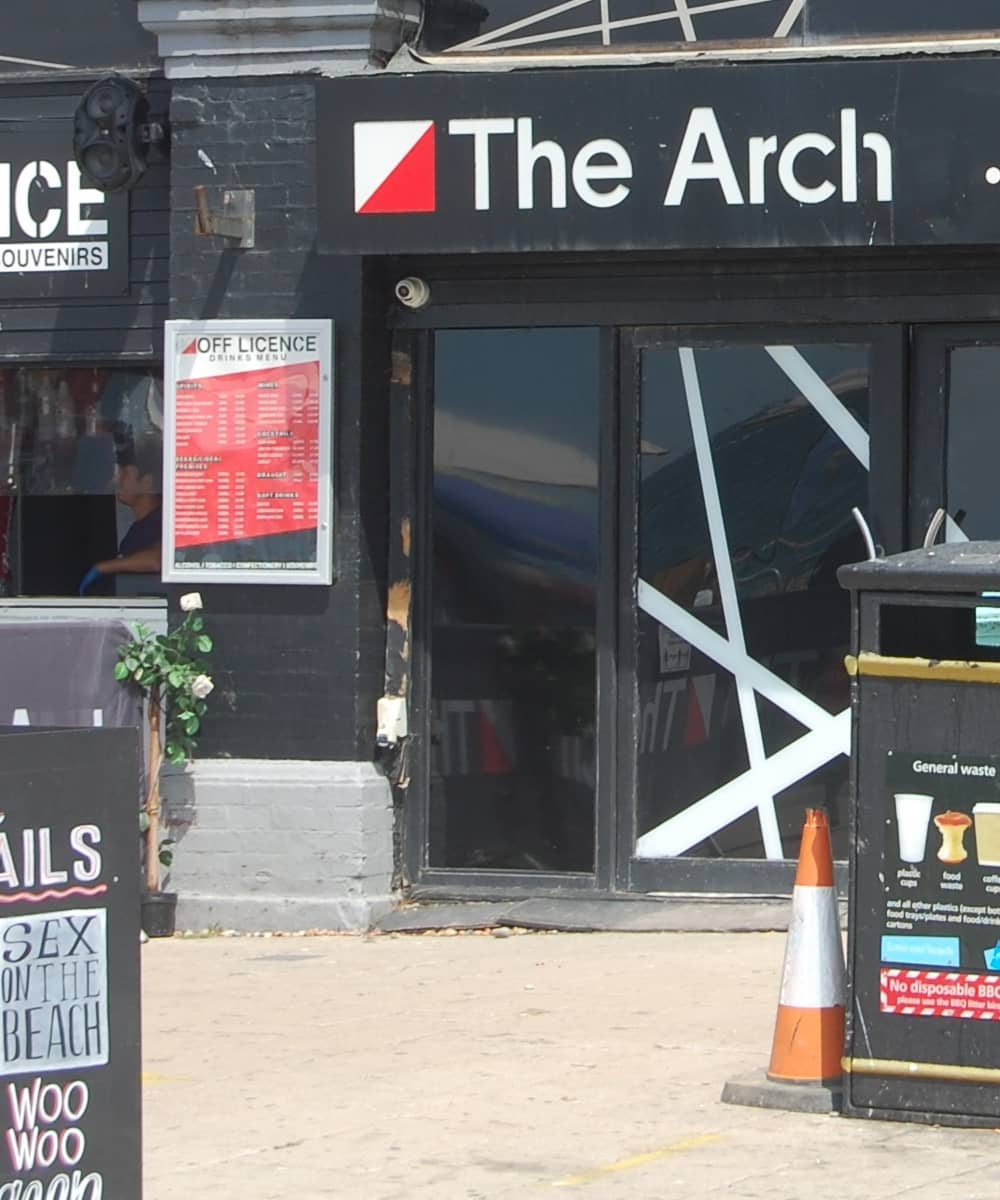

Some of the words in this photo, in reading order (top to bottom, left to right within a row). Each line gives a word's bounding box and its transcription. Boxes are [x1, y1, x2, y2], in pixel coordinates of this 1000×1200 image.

[449, 117, 633, 210] The
[663, 107, 892, 206] Arch
[0, 161, 108, 238] CE
[0, 246, 103, 268] OUVENIRS
[197, 337, 232, 353] OFF
[239, 335, 317, 352] LICENCE
[209, 354, 251, 362] DRINKS
[257, 353, 288, 361] MENU
[913, 760, 958, 774] General
[960, 764, 996, 777] waste
[2, 915, 98, 963] SEX
[1, 963, 32, 1003] ON
[36, 959, 100, 1003] THE
[889, 979, 908, 992] No
[911, 980, 975, 997] disposable
[3, 1001, 101, 1062] BEACH
[8, 1077, 88, 1131] WOO
[6, 1127, 85, 1171] WOO
